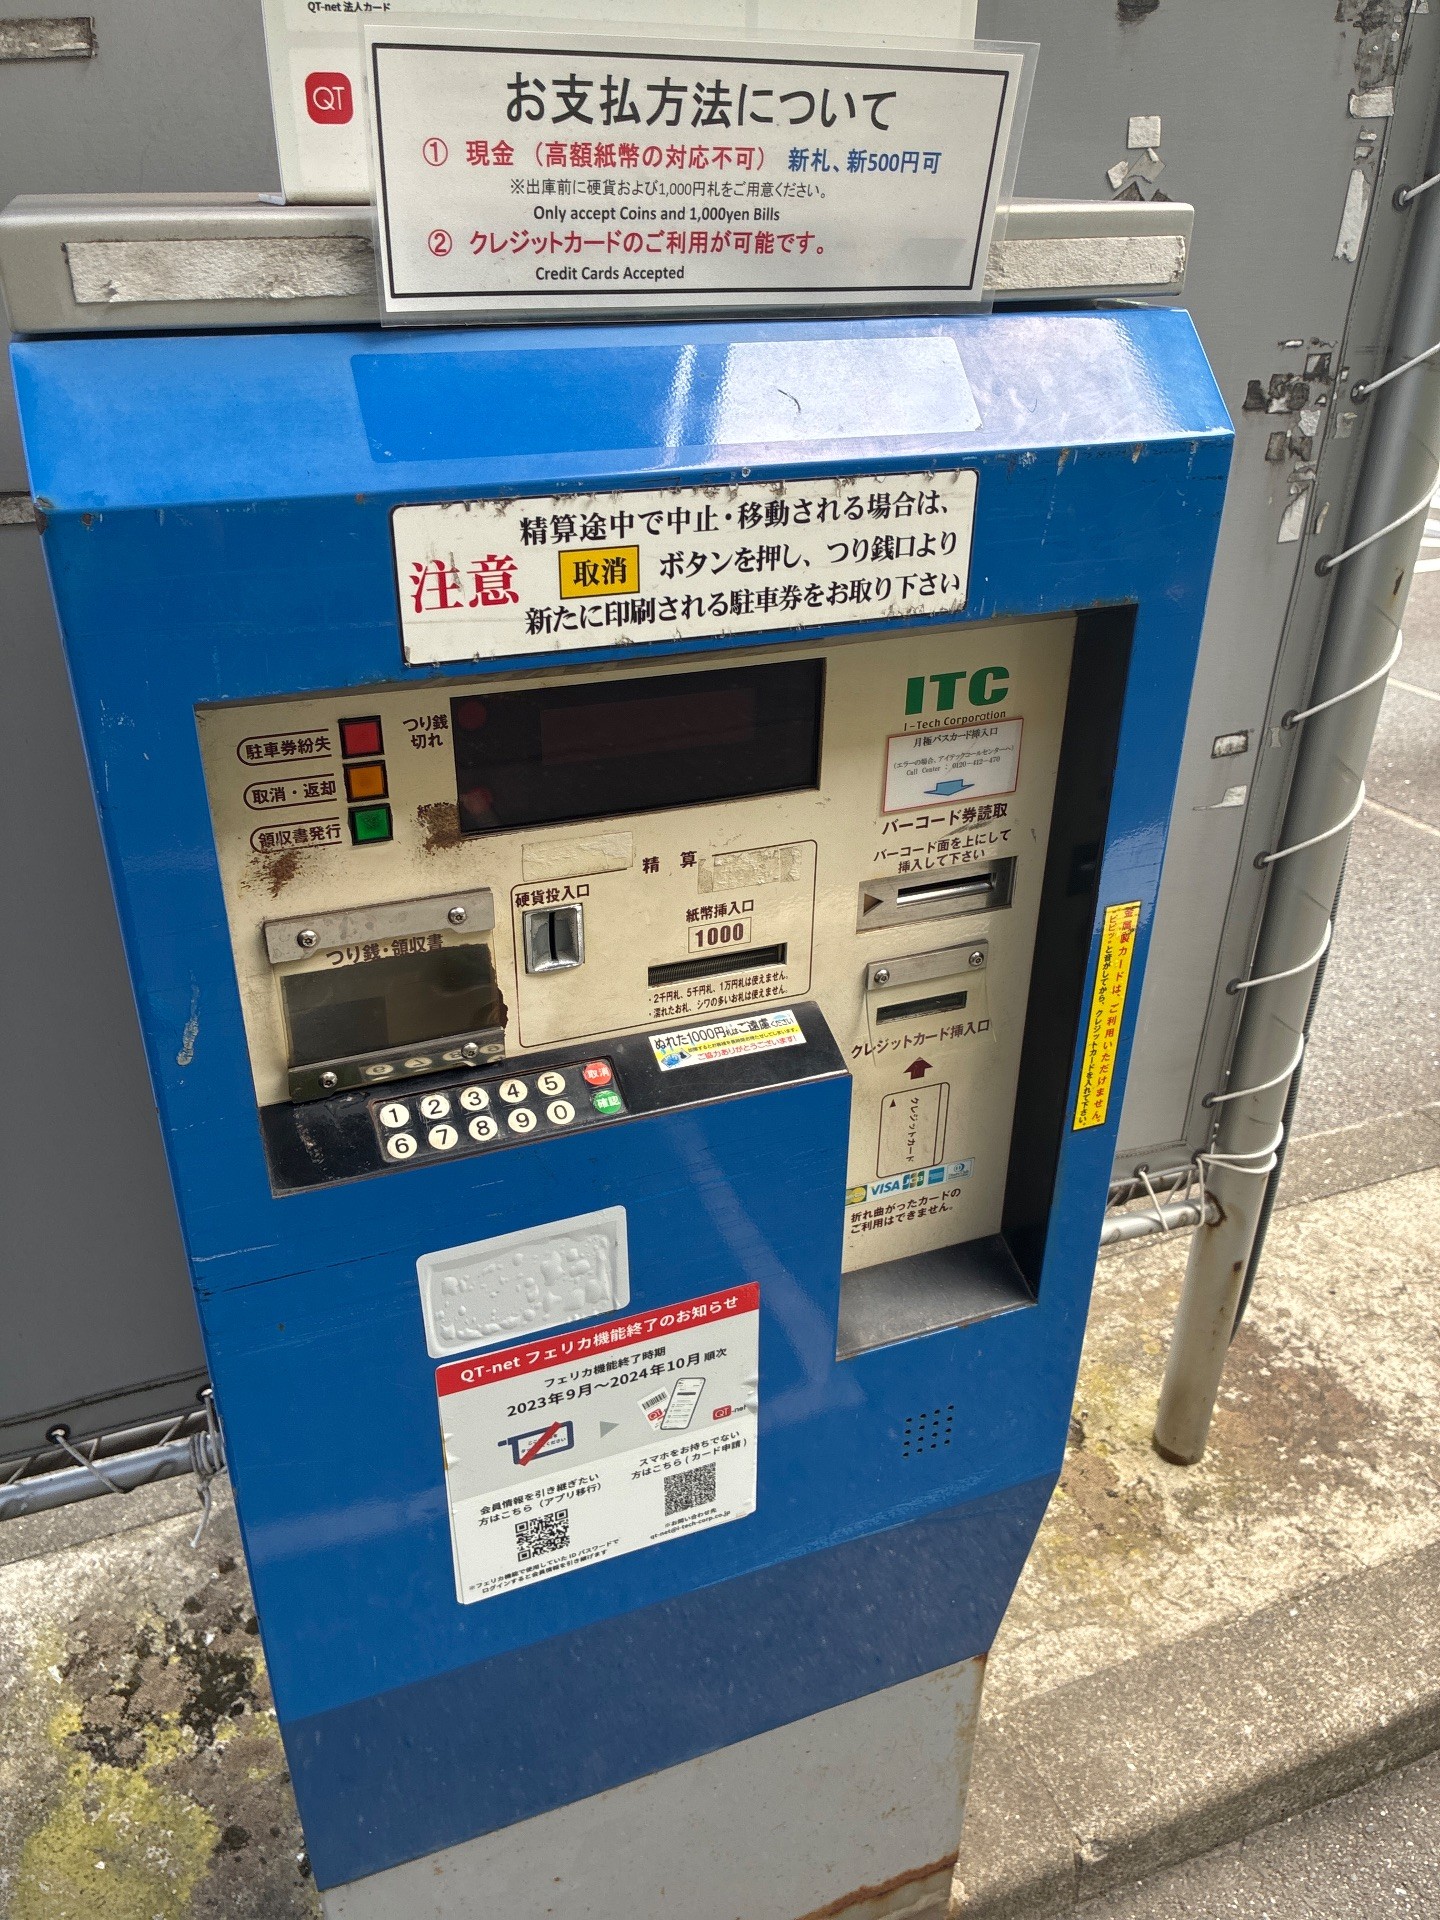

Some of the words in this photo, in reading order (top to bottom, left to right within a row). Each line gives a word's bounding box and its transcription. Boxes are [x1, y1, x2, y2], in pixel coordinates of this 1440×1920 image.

[307, 1, 341, 14] QT-net
[343, 1, 392, 13] 法人カード
[312, 86, 346, 111] QT
[506, 72, 897, 131] お支払方法について
[465, 140, 515, 167] 現金
[535, 141, 765, 171] （高額紙幣の対応不可）
[788, 147, 943, 174] 新札、新500円可
[510, 179, 826, 199] ※出庫前に硬貨および1,000円札をご用意ください。
[533, 206, 567, 223] Only
[569, 208, 616, 223] accept
[619, 206, 657, 221] Coins
[660, 206, 686, 221] and
[689, 207, 750, 224] 1,000yen
[753, 207, 781, 221] Bills
[469, 230, 824, 256] クレジットカードのご利用が可能です。
[535, 266, 578, 281] Credit
[581, 266, 620, 281] Cards
[622, 266, 685, 282] Accepted
[519, 490, 949, 547] 精算途中で中止・移動される場合は、
[571, 556, 628, 588] 取消
[658, 530, 957, 580] ボタンを押し、つり銭口より
[408, 553, 520, 614] 注意
[524, 572, 961, 636] 新たに印刷される駐車券をお取り下さい
[904, 665, 1010, 716] ITC
[402, 714, 449, 732] つり銭
[943, 709, 1006, 727] Corporation
[245, 736, 332, 760] 駐車券紛失
[410, 732, 444, 750] 切れ
[912, 727, 999, 748] 月極パスカード挿入口
[906, 767, 919, 777] Call
[921, 765, 941, 775] Center
[251, 780, 337, 805] 取消・返却
[881, 803, 1008, 836] バーコード券読取
[258, 823, 341, 850] 領収書発行
[873, 828, 1012, 861] バーコード面を上にして
[897, 848, 986, 874] 挿入して下さい
[515, 883, 590, 908] 硬貨投入口
[686, 899, 755, 923] 紙幣挿入口
[325, 932, 444, 966] つり銭・領収書
[695, 922, 744, 948] 1000
[850, 1018, 990, 1059] クレジットカード挿入口
[428, 1100, 442, 1115] 2
[467, 1091, 482, 1106] 3
[507, 1083, 520, 1098] 4
[545, 1076, 558, 1091] 5
[587, 1067, 610, 1079] 取消
[395, 1138, 409, 1154] 6
[476, 1120, 490, 1136] 8
[516, 1113, 530, 1128] 9
[554, 1105, 567, 1120] 0
[905, 1096, 920, 1162] クレジットカード
[871, 1180, 900, 1196] VISA
[850, 1188, 961, 1223] 折れ曲がったカードの
[850, 1202, 953, 1234] ご利用はできません。
[460, 1356, 521, 1383] QT-net
[525, 1295, 739, 1364] フェリカ機能終了のお知らせ
[544, 1346, 667, 1388] フェリカ機能終了時期
[703, 1347, 728, 1363] 順次
[639, 1430, 740, 1467] スマホをお持ちでない
[479, 1473, 600, 1516] 会員情報を引き継ぎたい
